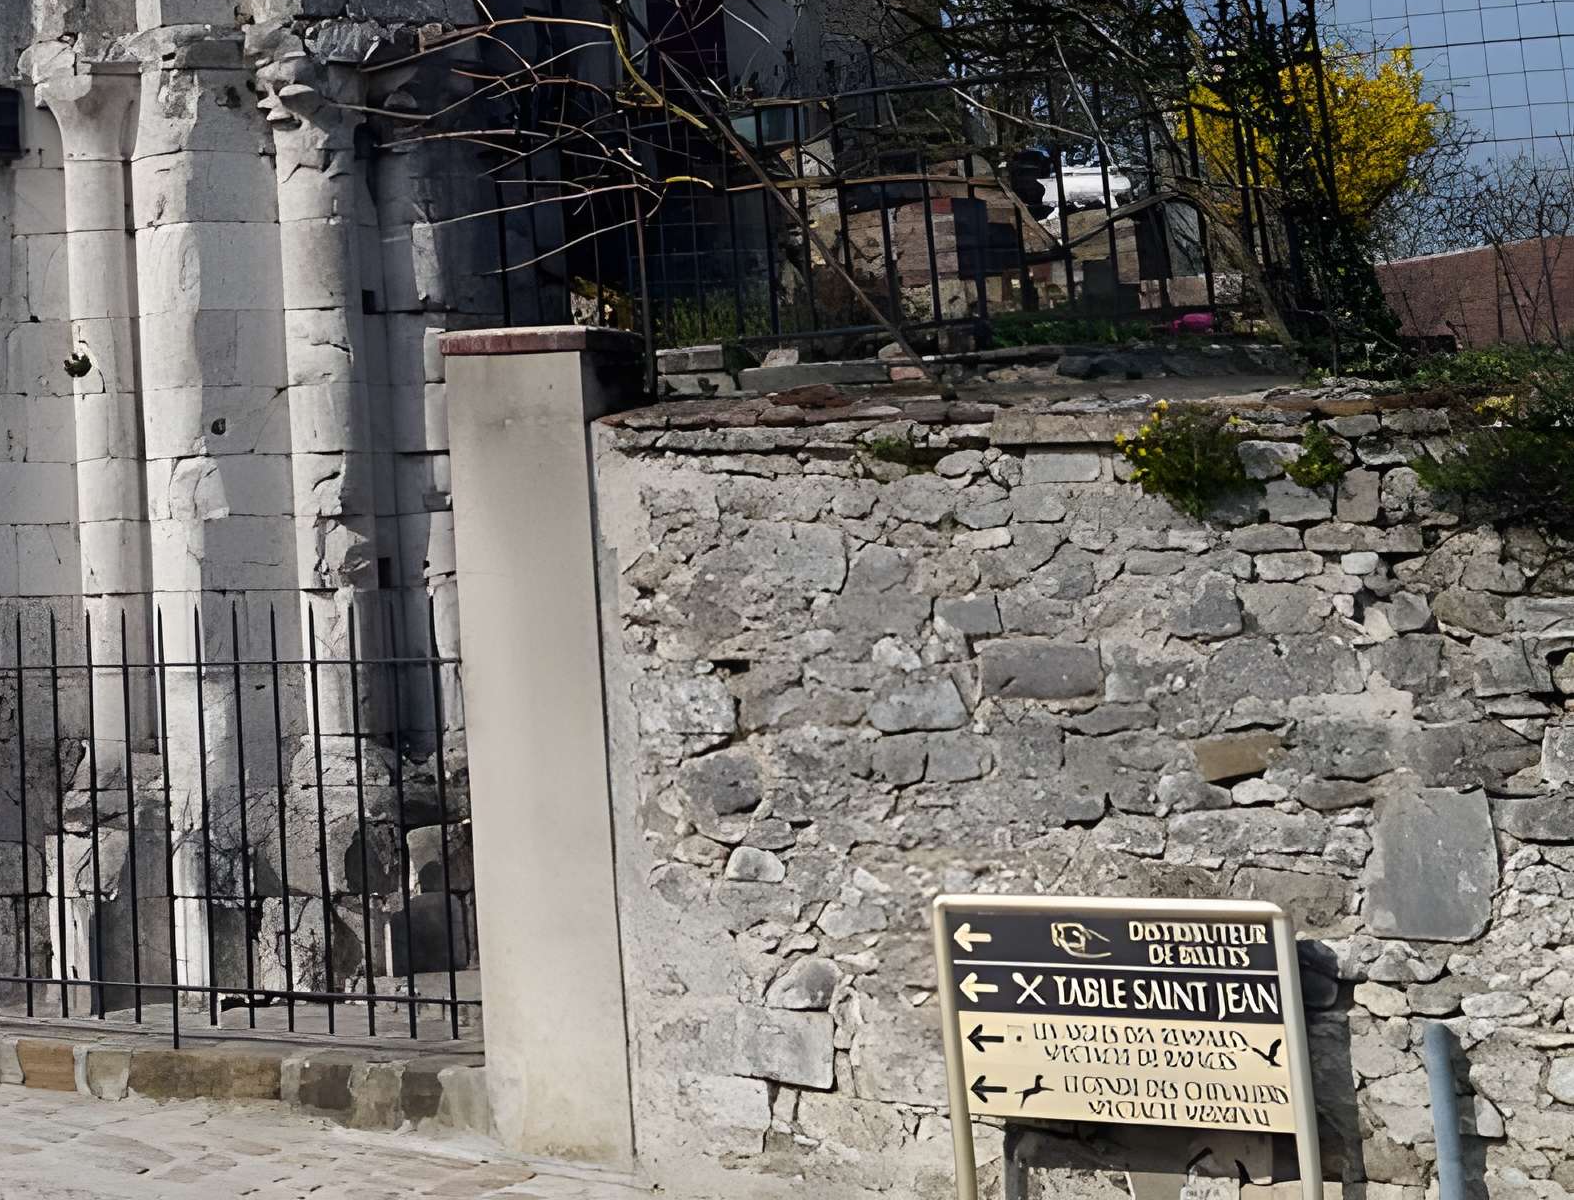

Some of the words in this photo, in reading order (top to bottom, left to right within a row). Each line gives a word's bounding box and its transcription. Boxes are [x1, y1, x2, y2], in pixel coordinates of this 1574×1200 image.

[1128, 920, 1268, 944] DTUTEUR
[1148, 943, 1174, 965] DE
[1052, 975, 1128, 1009] TABLE
[1133, 979, 1208, 1012] SAINT
[1216, 982, 1279, 1021] JEAN
